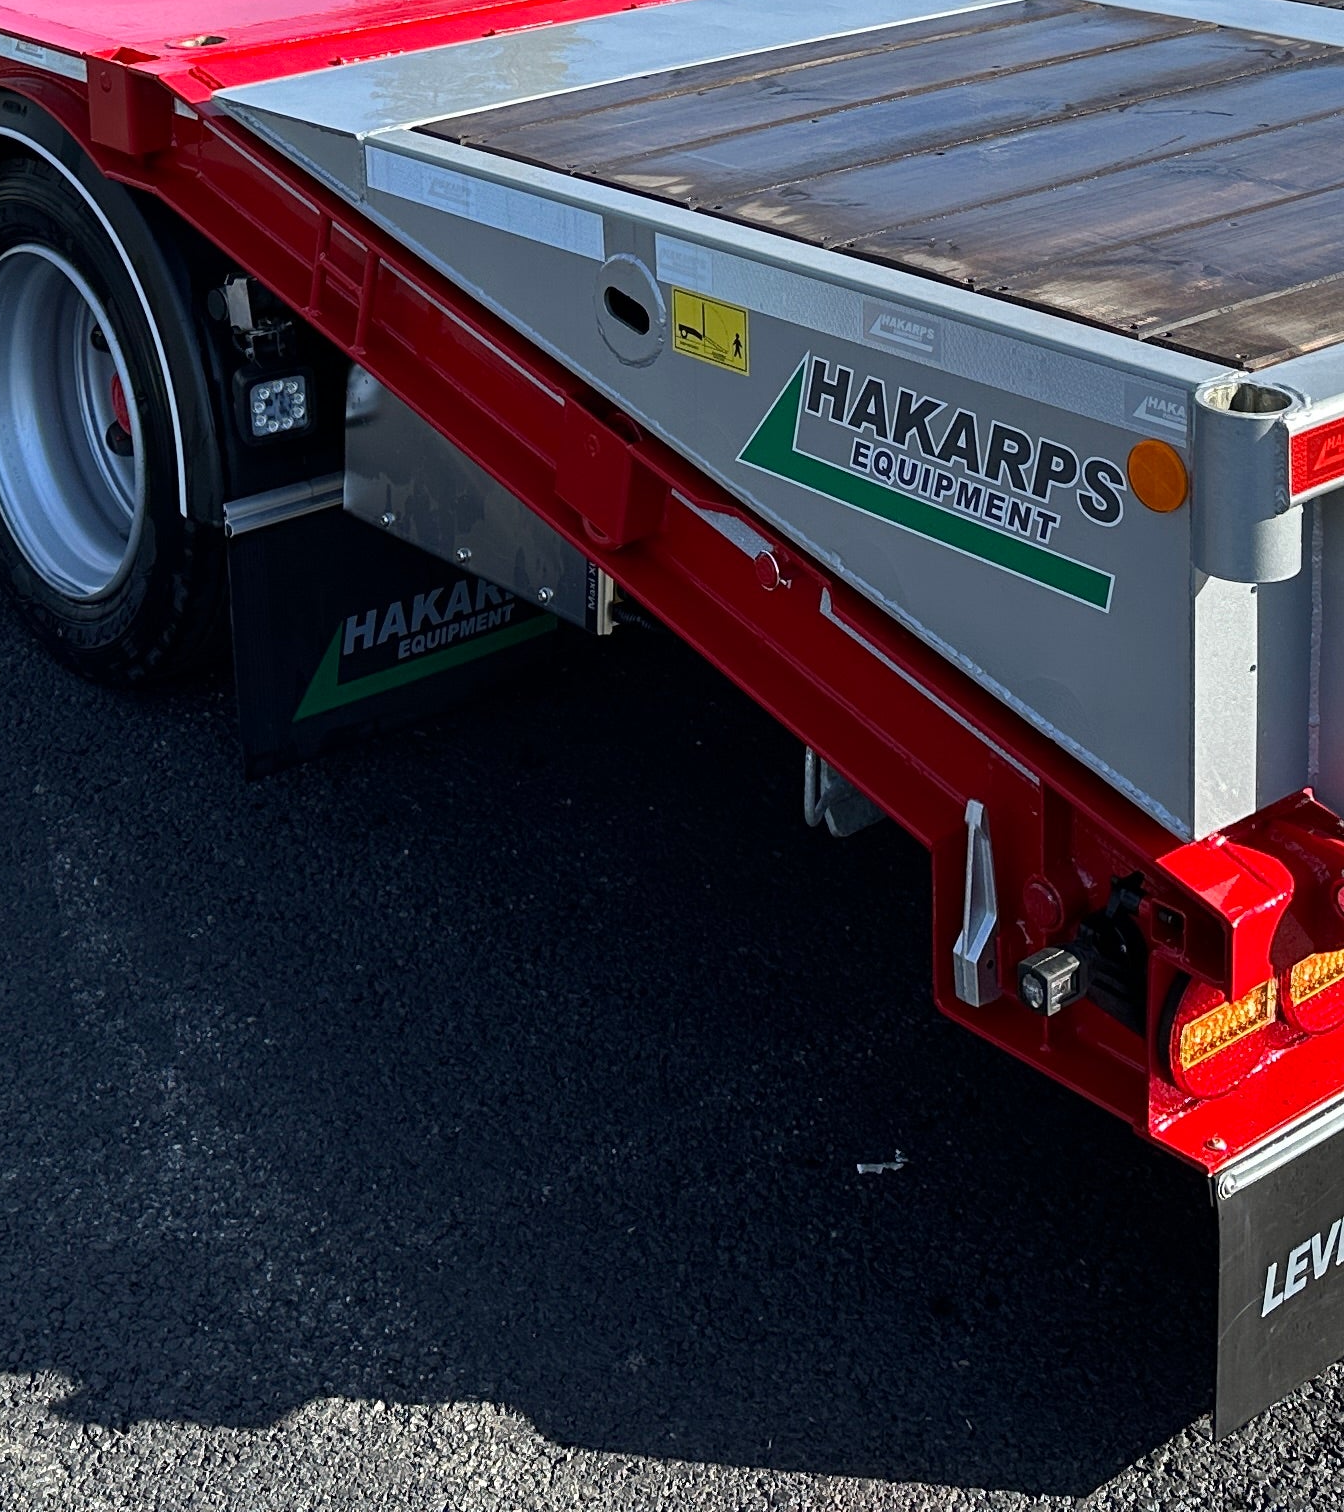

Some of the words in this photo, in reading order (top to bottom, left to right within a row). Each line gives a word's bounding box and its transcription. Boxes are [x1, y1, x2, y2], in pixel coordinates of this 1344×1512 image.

[880, 313, 935, 340] HAKARPS
[805, 357, 1125, 526] HAKARPS
[849, 437, 1062, 543] EQUIPMENT
[343, 577, 514, 657] HAKAR
[397, 603, 516, 660] EQUIPMENT
